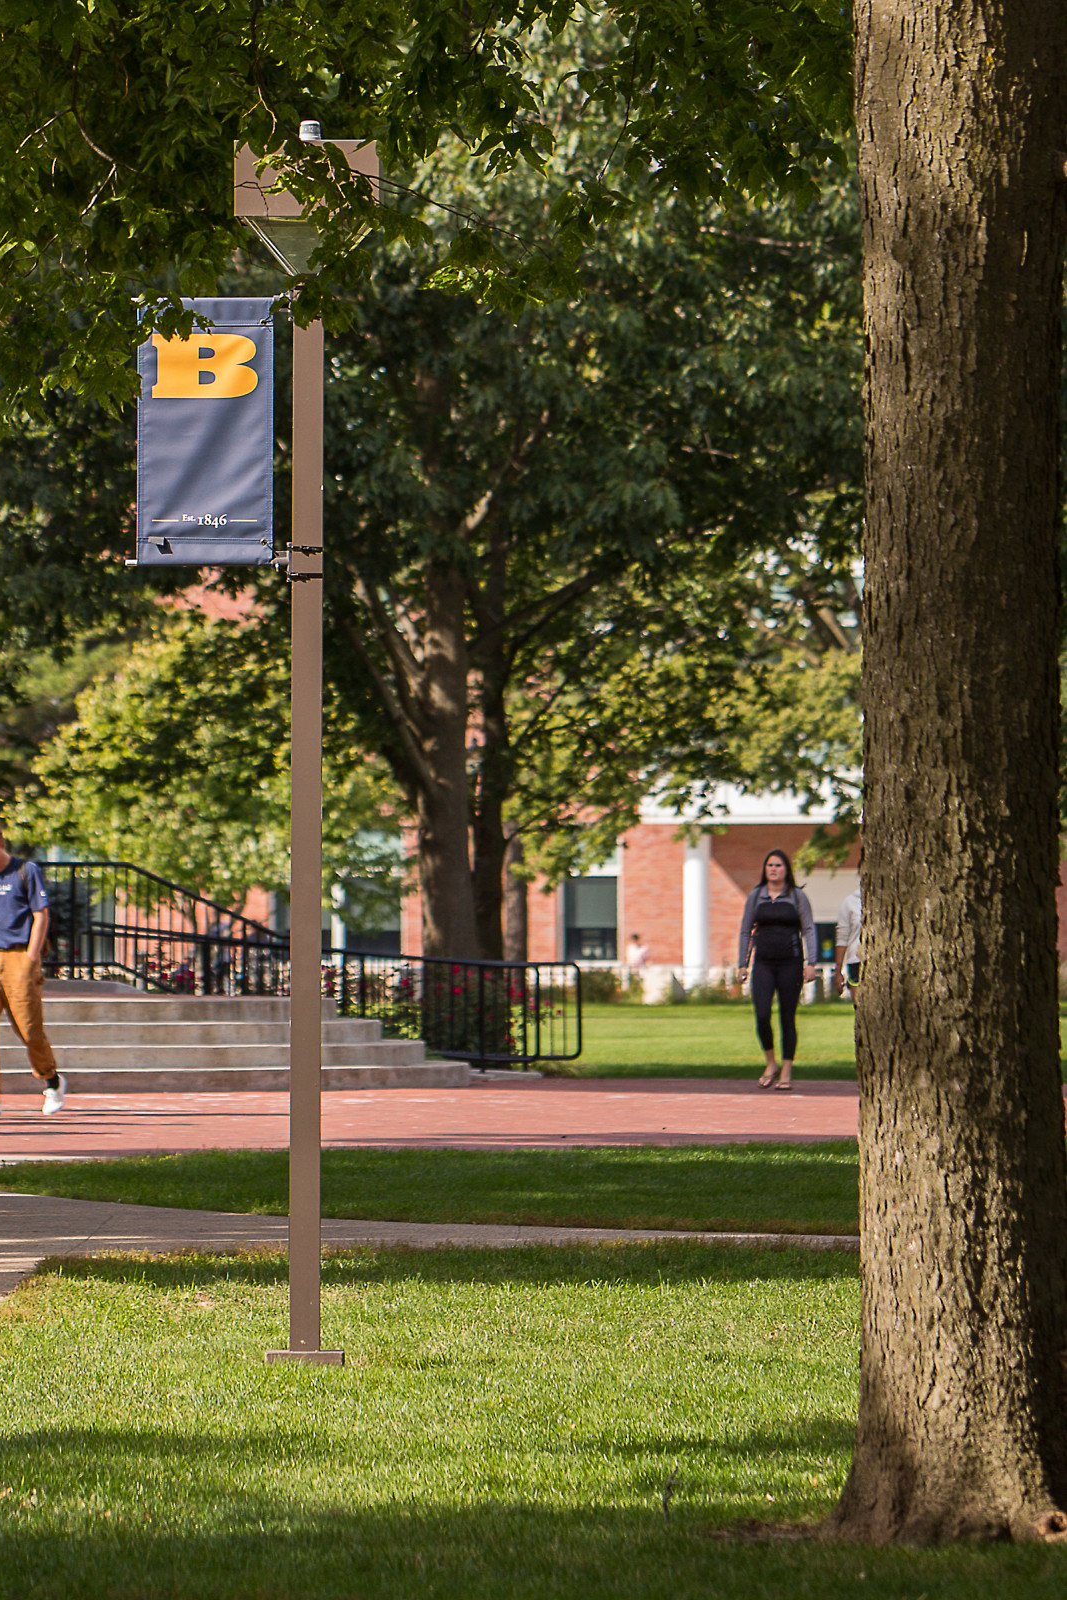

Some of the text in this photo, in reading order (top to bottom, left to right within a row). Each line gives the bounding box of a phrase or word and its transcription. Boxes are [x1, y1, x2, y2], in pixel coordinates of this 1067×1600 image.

[151, 333, 259, 399] B
[181, 513, 228, 529] Est. 1846
